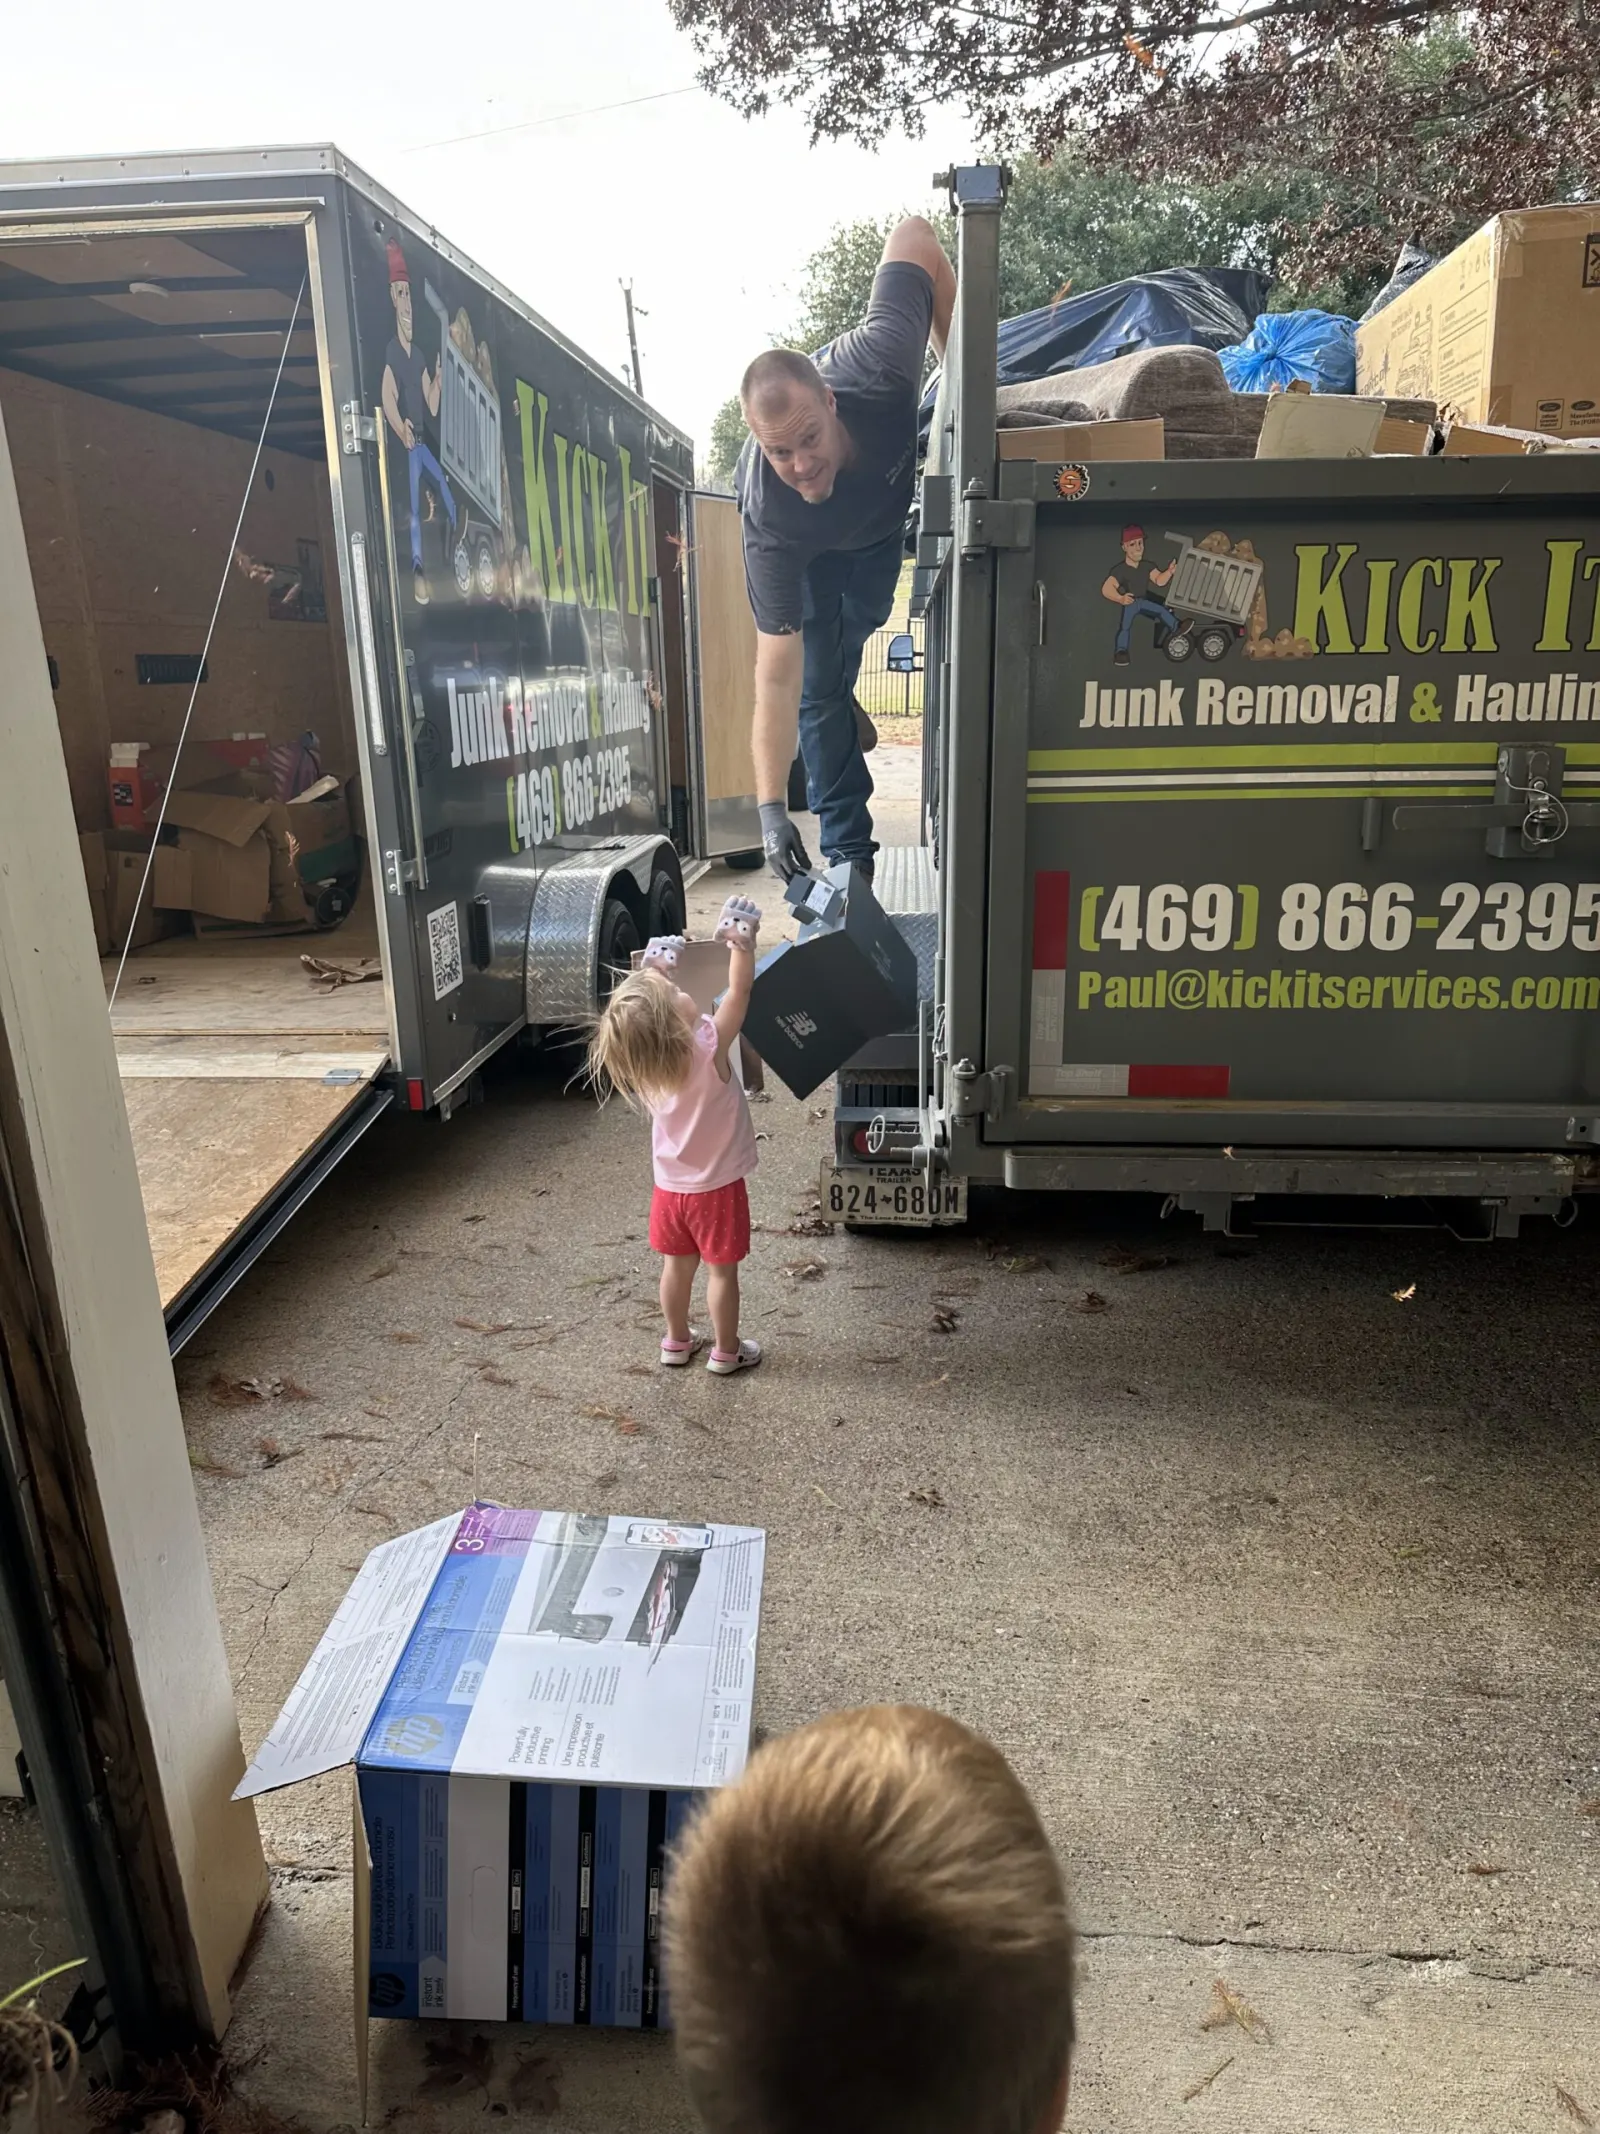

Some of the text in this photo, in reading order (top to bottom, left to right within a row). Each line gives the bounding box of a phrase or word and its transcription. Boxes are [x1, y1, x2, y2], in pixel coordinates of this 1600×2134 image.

[1293, 543, 1502, 654] KICK
[447, 669, 651, 768] Junk Removal & Hauling
[1079, 674, 1600, 727] Junk Removal & Haulin
[506, 745, 632, 853] (469) 866-2395
[1079, 882, 1600, 951] (469) 866-2395
[1078, 969, 1600, 1010] Paul@kickitservices.com
[774, 1015, 804, 1050] new balance
[876, 1176, 912, 1184] TRAILER
[454, 1538, 485, 1551] 3
[508, 1726, 530, 1763] Powerfully
[524, 1726, 541, 1764] productive
[537, 1738, 554, 1765] printing
[560, 1713, 583, 1766] Une impression
[576, 1730, 592, 1767] productive
[590, 1733, 605, 1768] puissante
[423, 1977, 433, 2008] instant
[433, 1994, 444, 2008] ink
